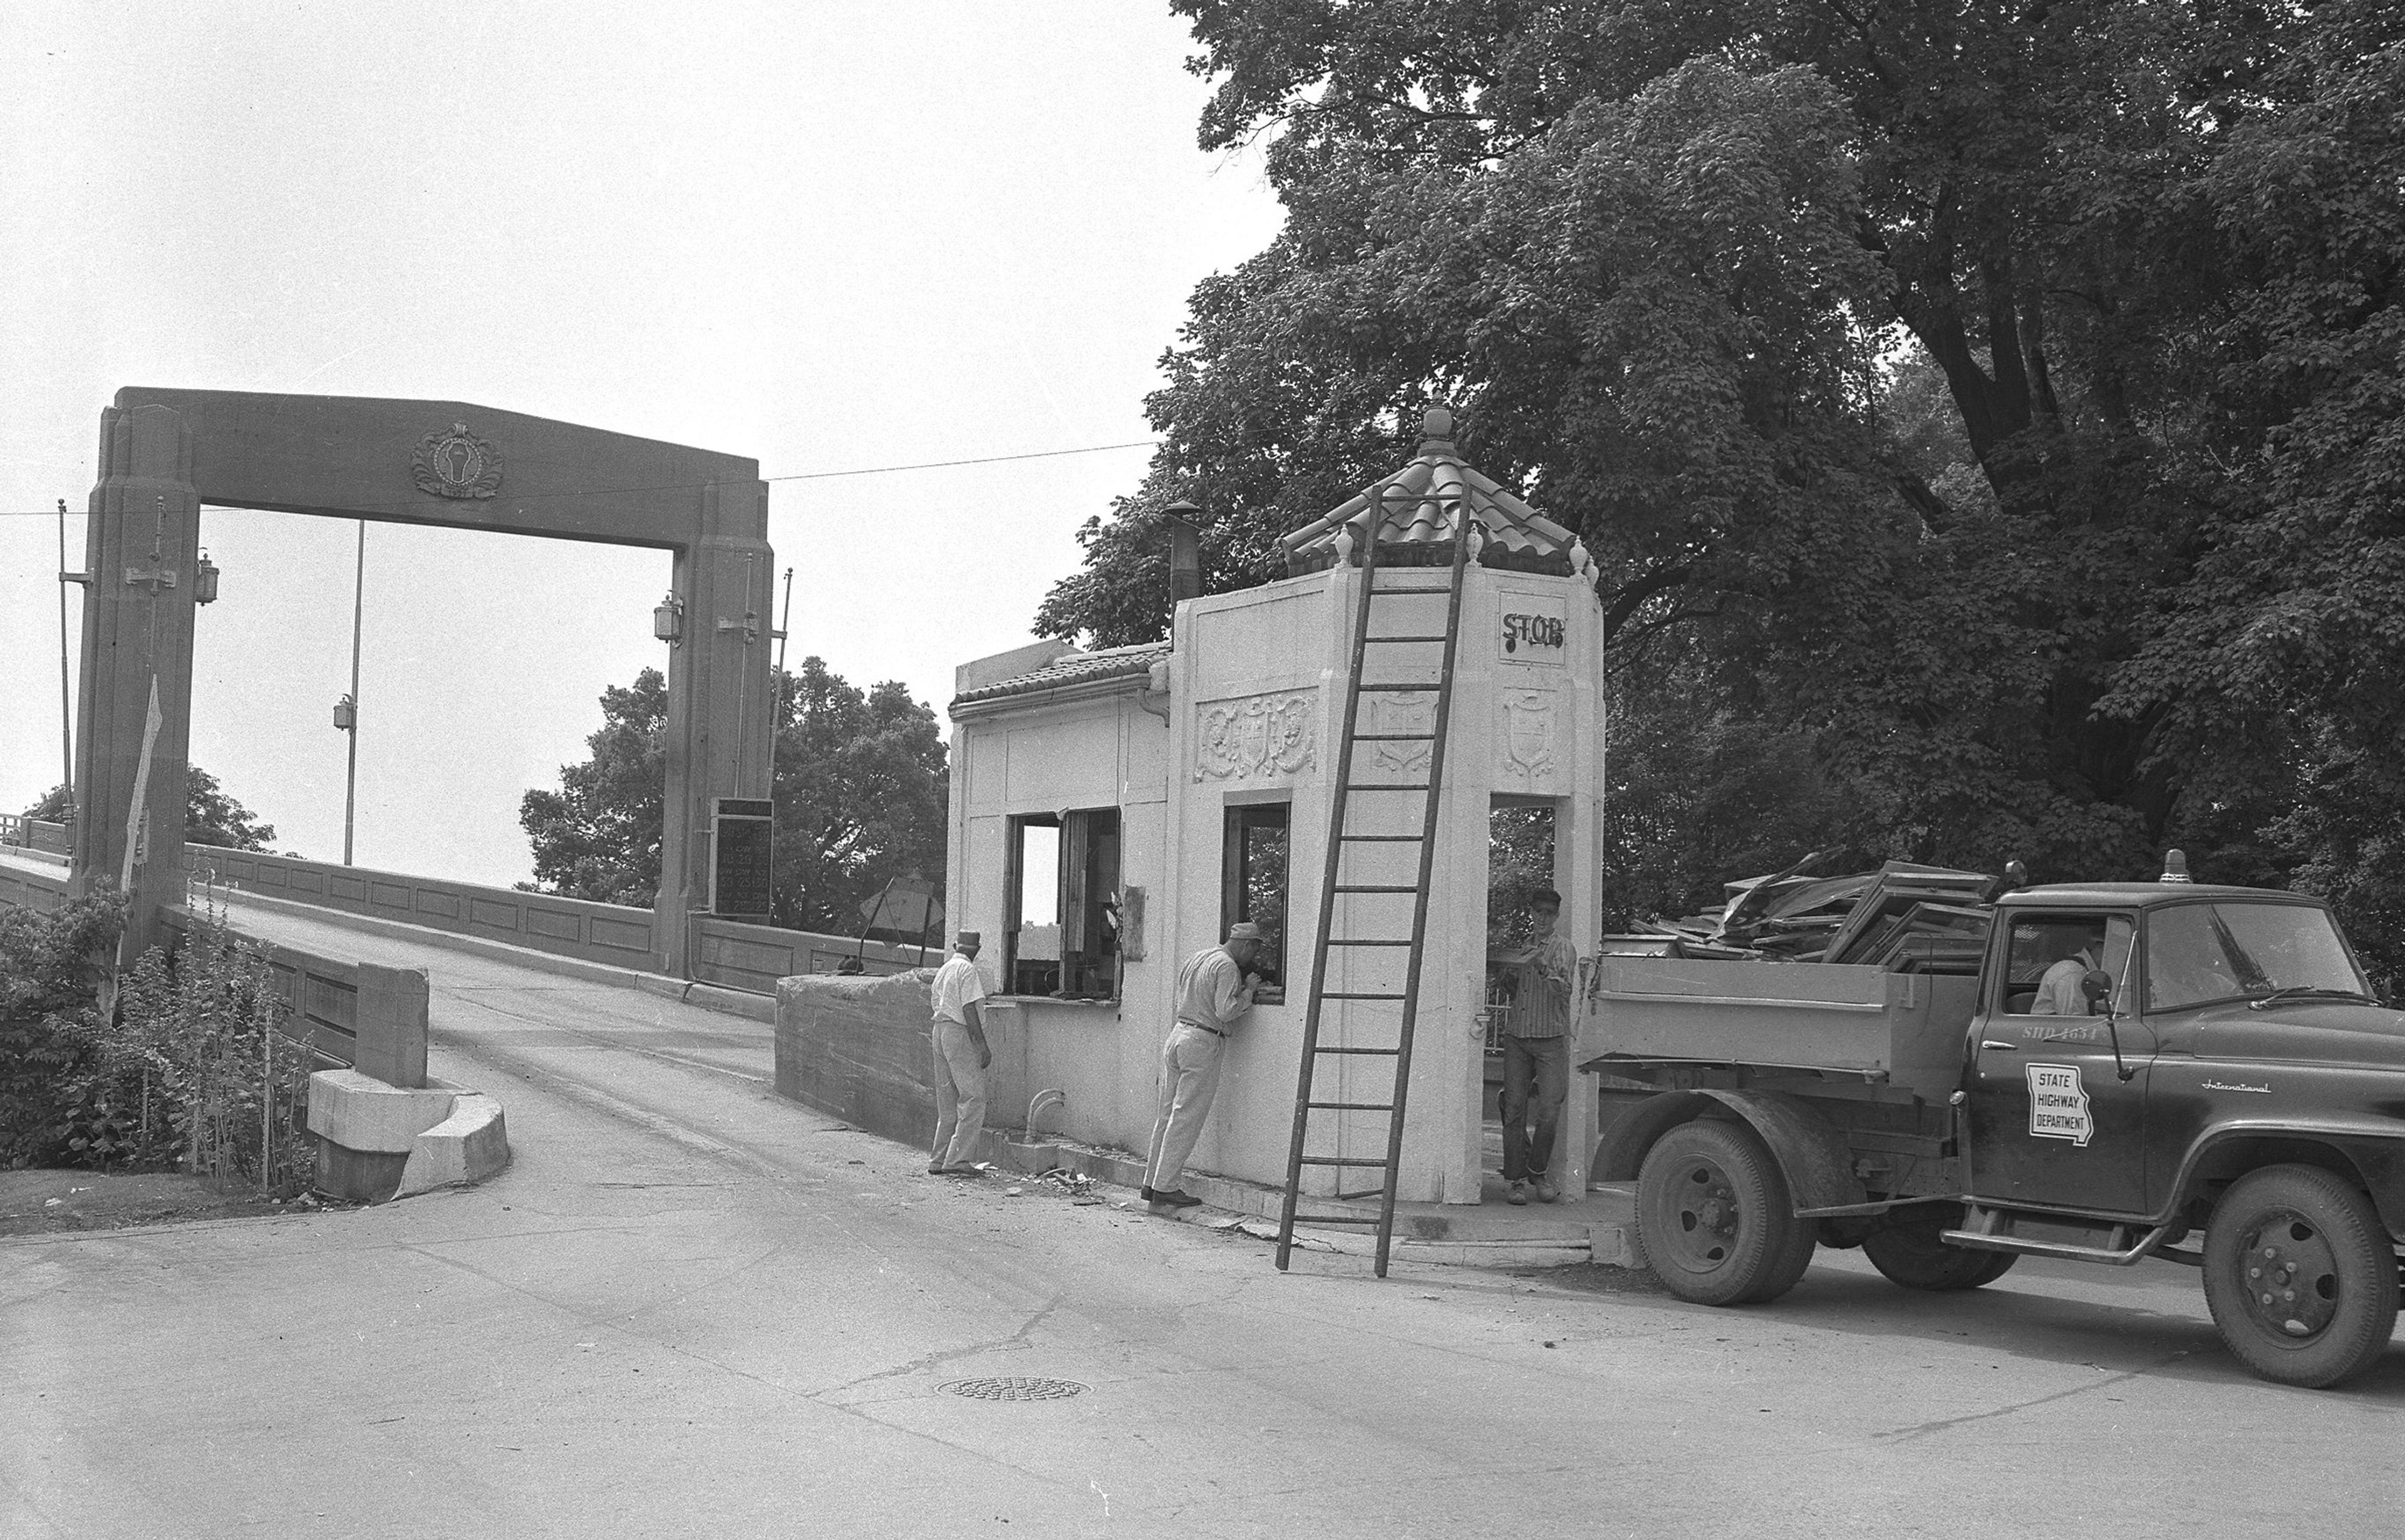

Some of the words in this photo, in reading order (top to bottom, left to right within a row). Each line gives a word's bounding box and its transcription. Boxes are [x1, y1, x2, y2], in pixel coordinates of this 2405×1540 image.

[2039, 1073, 2070, 1088] STATE
[2201, 1078, 2272, 1093] International
[2037, 1093, 2079, 1108] HIGHWAY
[2037, 1114, 2085, 1130] DEPARTMENT
